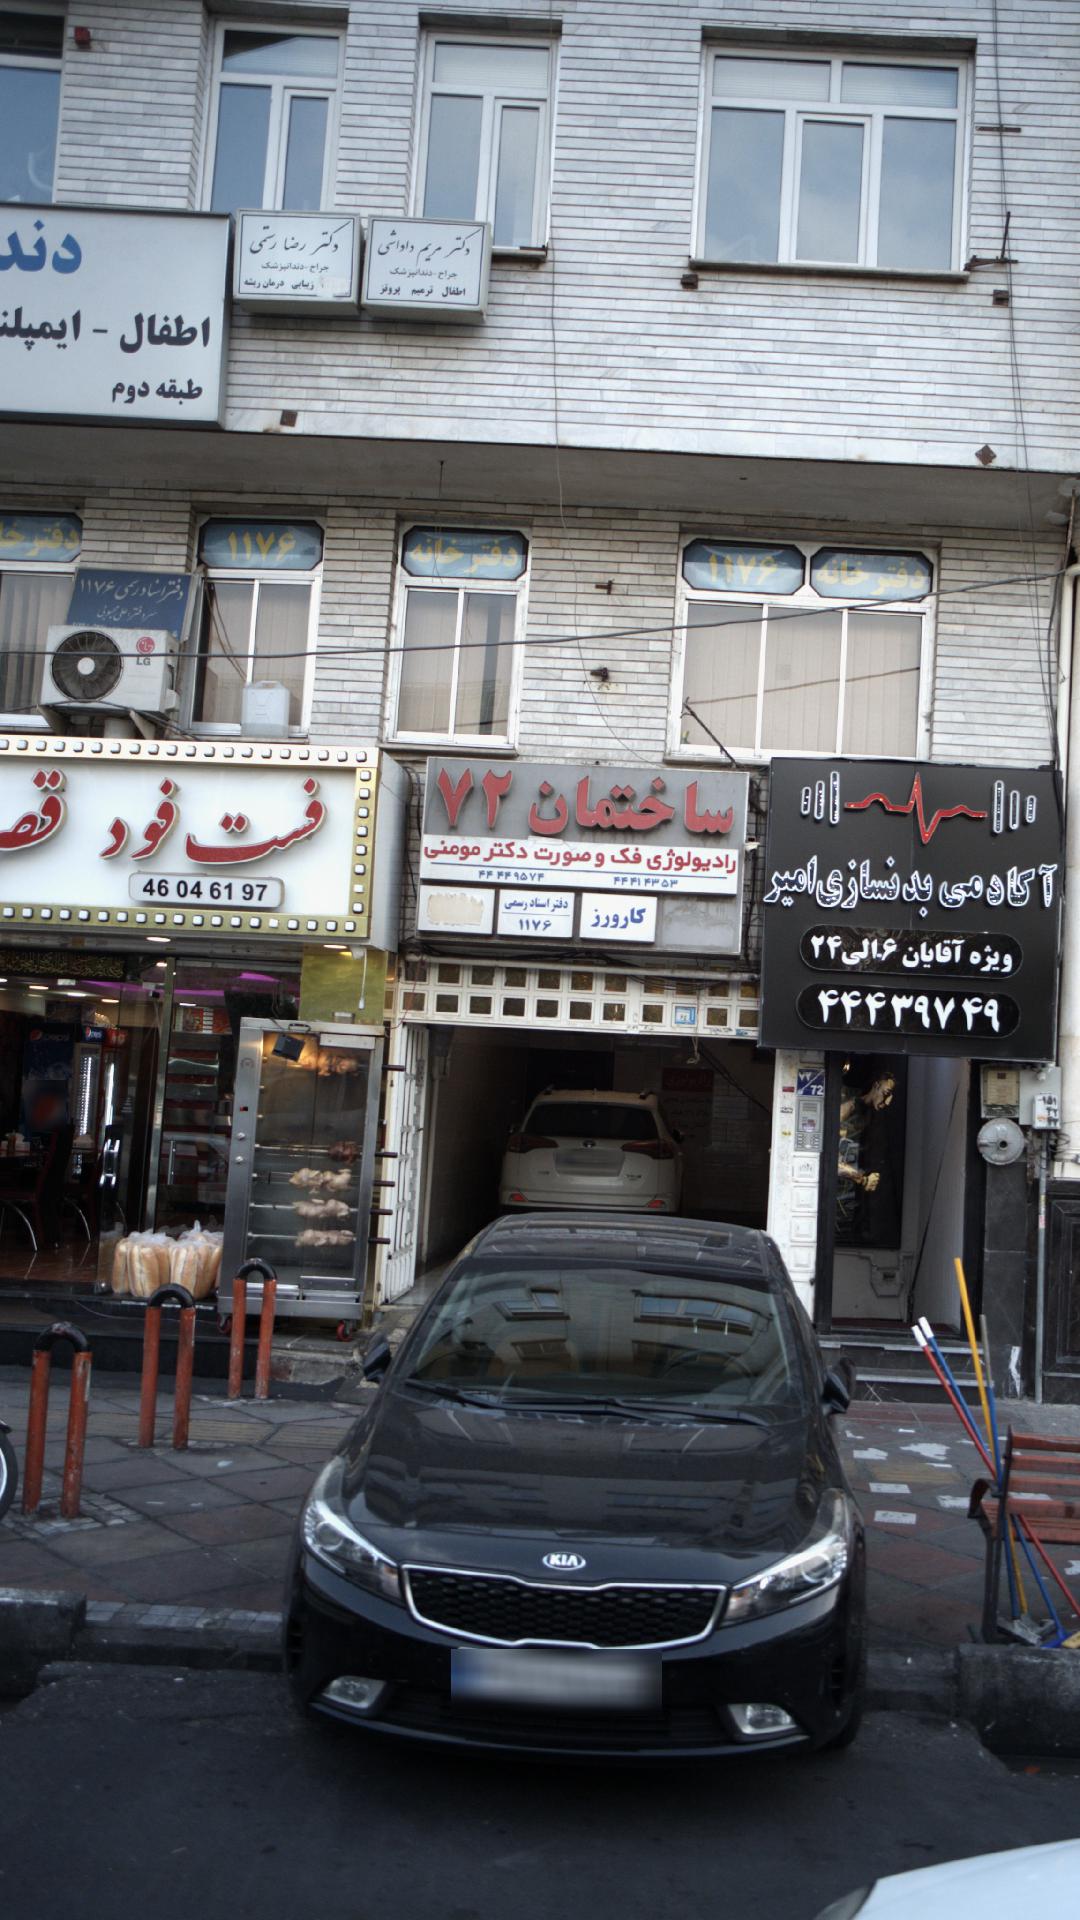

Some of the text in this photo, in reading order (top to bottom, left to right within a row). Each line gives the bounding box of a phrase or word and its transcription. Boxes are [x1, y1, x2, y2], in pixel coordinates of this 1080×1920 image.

[0, 219, 82, 274] دند
[250, 221, 351, 255] دکتر رضا رستمی
[443, 228, 481, 258] دکتر
[416, 243, 442, 266] مریم
[244, 278, 260, 288] ریشه
[263, 279, 284, 289] درمان
[291, 279, 314, 290] زیبایی
[379, 284, 466, 297] اطفال ترمیم پروتز
[0, 306, 81, 351] ایمپلن
[119, 312, 210, 353] اطفال
[111, 378, 203, 405] طبقه دوم
[228, 531, 296, 561] ۱۱۷۶
[709, 553, 777, 586] ۱۱۷۶
[81, 579, 115, 594] ۱۱۷۶
[114, 580, 140, 600] رسمی
[157, 579, 183, 604] دفتر
[136, 657, 151, 666] LG
[437, 767, 735, 835] ساختمان ۷۲
[99, 777, 180, 860] فود
[185, 777, 327, 865] فست
[424, 840, 736, 873] رادیولوژی فک و صورت دکتر مومنی
[763, 855, 817, 907] امیر
[939, 863, 1058, 908] آکادمی
[505, 896, 568, 912] دفتر اسناد رسمی
[518, 919, 552, 931] ۱۱۷۶
[590, 907, 646, 929] کارورز
[810, 935, 842, 960] ۲۴
[902, 939, 965, 968] آقایان
[969, 945, 1013, 972] ویژه
[811, 1085, 824, 1095] 72
[549, 1554, 579, 1567] KIA
